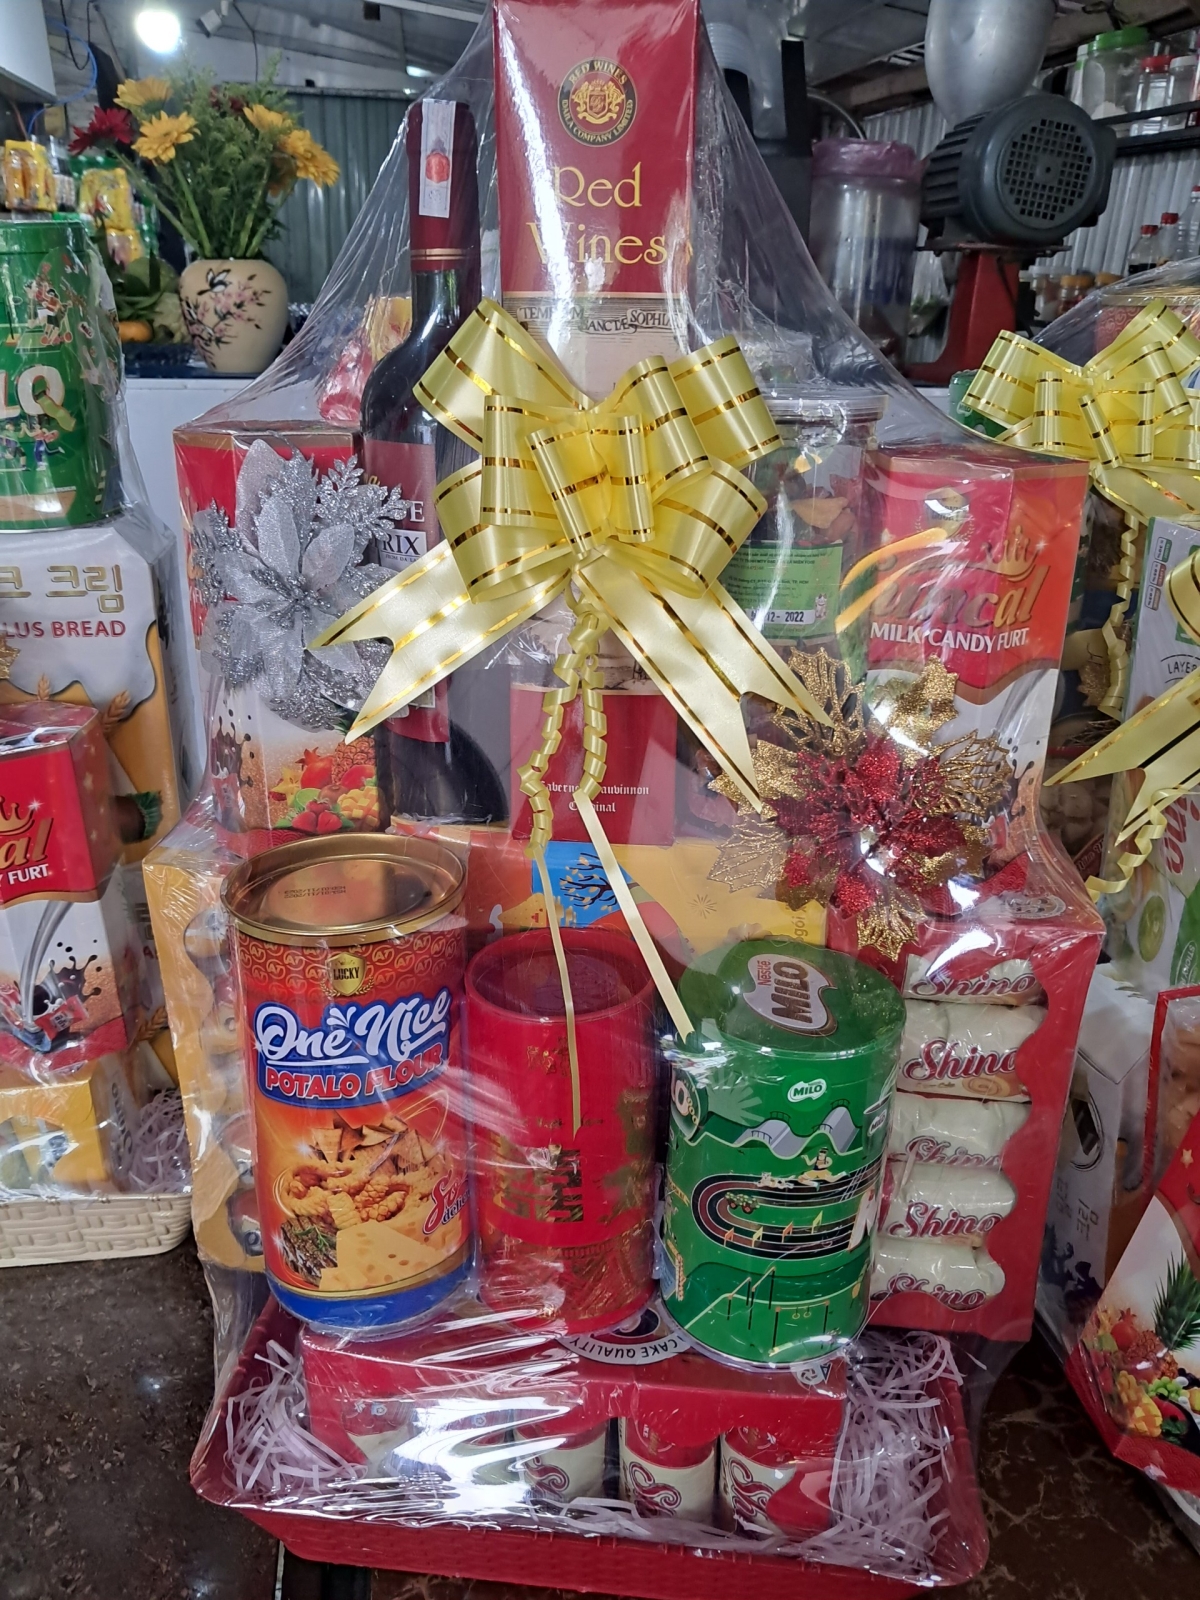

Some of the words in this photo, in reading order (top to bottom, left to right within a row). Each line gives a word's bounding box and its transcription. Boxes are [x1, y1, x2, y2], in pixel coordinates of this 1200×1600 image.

[568, 62, 590, 84] RED
[594, 61, 628, 85] WINES
[573, 128, 612, 143] COMPANY
[553, 162, 642, 208] Red
[46, 564, 125, 613] 크림
[785, 611, 804, 622] 2022
[51, 620, 126, 638] BREAD
[870, 621, 922, 645] MILK
[928, 628, 996, 654] CANDY
[996, 627, 1029, 651] FURT
[540, 781, 580, 793] aberne
[601, 784, 649, 795] auvinnon
[8, 863, 50, 886] FURT
[333, 967, 360, 980] LUCKY
[912, 973, 1036, 996] Shino
[771, 961, 813, 1024] MILO
[256, 1006, 352, 1061] One
[354, 990, 451, 1062] Nice
[903, 1037, 1019, 1081] Shino
[266, 1066, 361, 1099] POTALO
[365, 1043, 443, 1095] FLOUR
[793, 1085, 823, 1097] MILO
[887, 1201, 1004, 1238] Shino
[568, 1336, 637, 1359] QUALITY
[641, 1338, 678, 1359] CAKE
